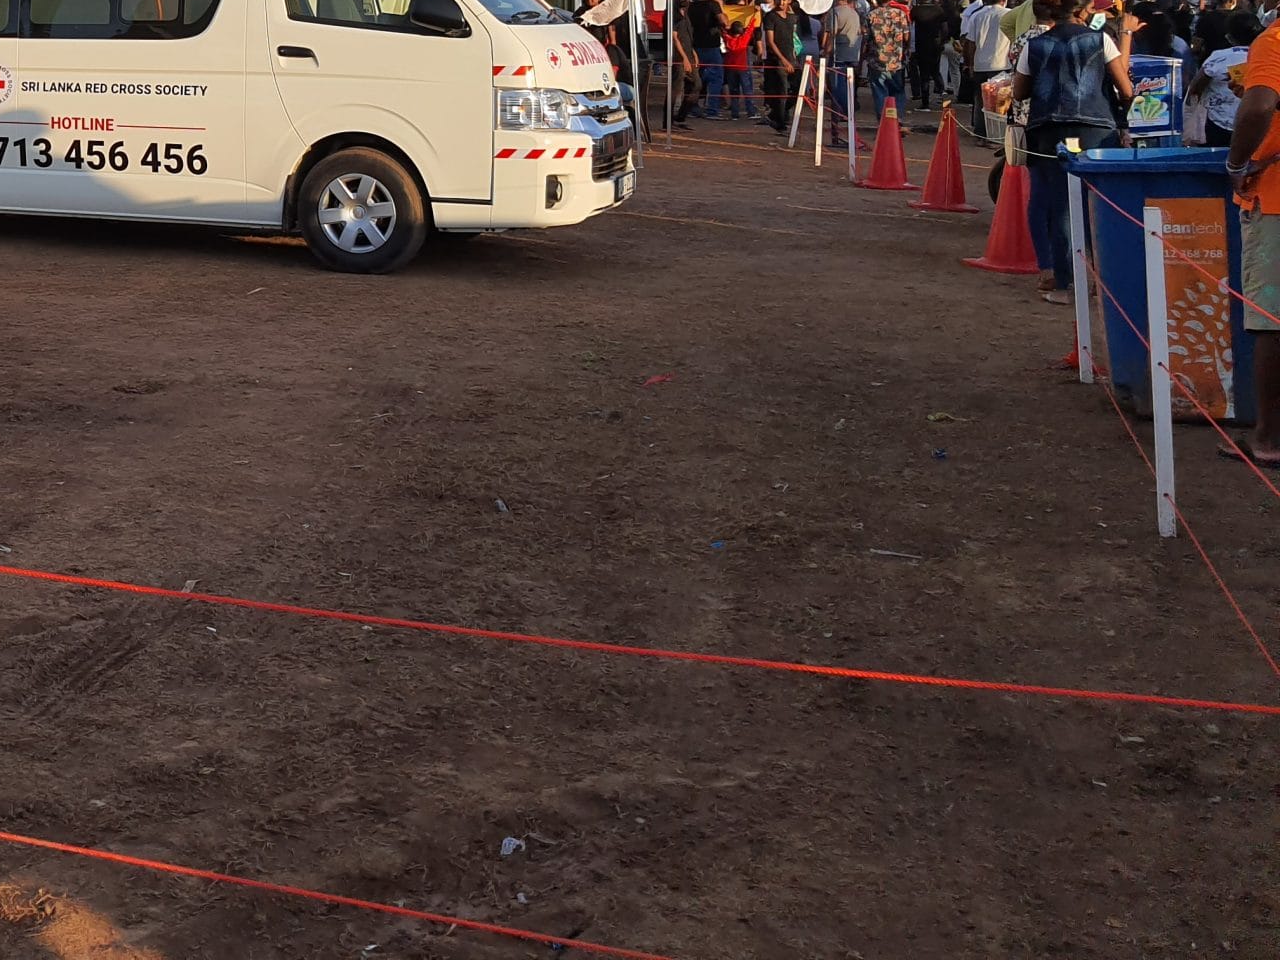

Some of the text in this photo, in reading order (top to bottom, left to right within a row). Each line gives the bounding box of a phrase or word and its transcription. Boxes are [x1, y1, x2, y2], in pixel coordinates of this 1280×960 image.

[21, 81, 208, 96] SRI LANKA RED CROSS SOCIETY
[51, 116, 114, 131] HOTLINE
[64, 139, 129, 171] 456
[140, 143, 207, 175] 456
[1162, 222, 1223, 234] eantech
[1203, 250, 1223, 258] 768
